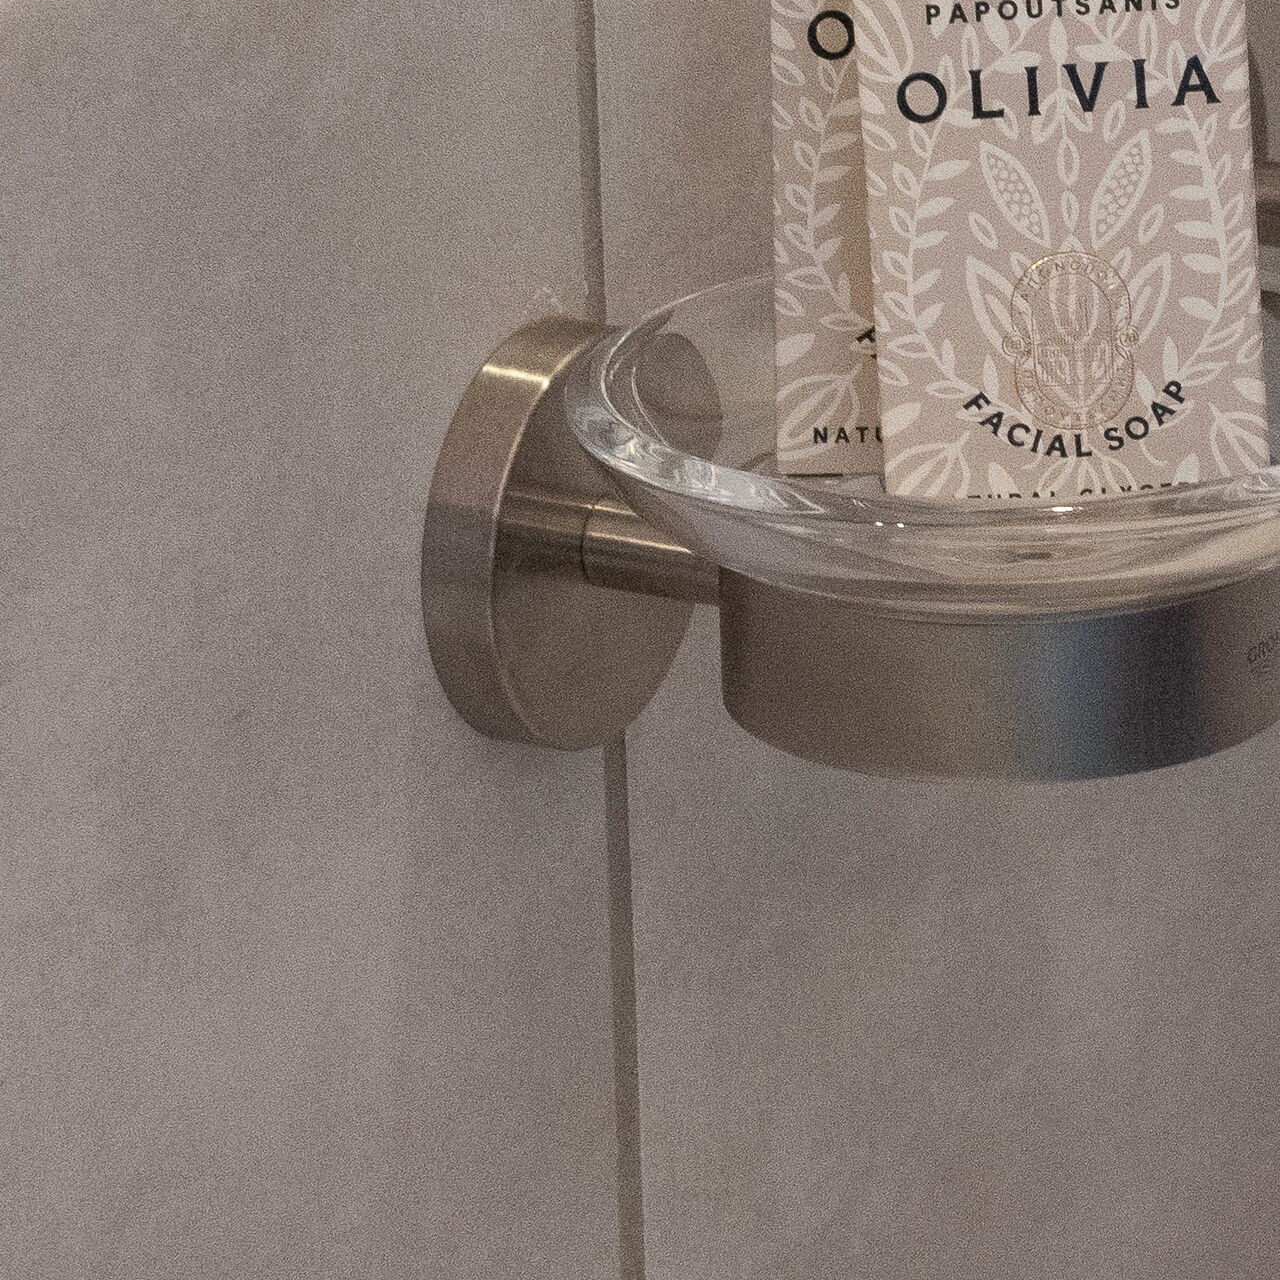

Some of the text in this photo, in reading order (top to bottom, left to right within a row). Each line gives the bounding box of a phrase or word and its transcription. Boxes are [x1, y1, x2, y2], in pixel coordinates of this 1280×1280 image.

[896, 55, 1222, 124] OLIVIA
[962, 378, 1190, 459] FACIAL SOAP
